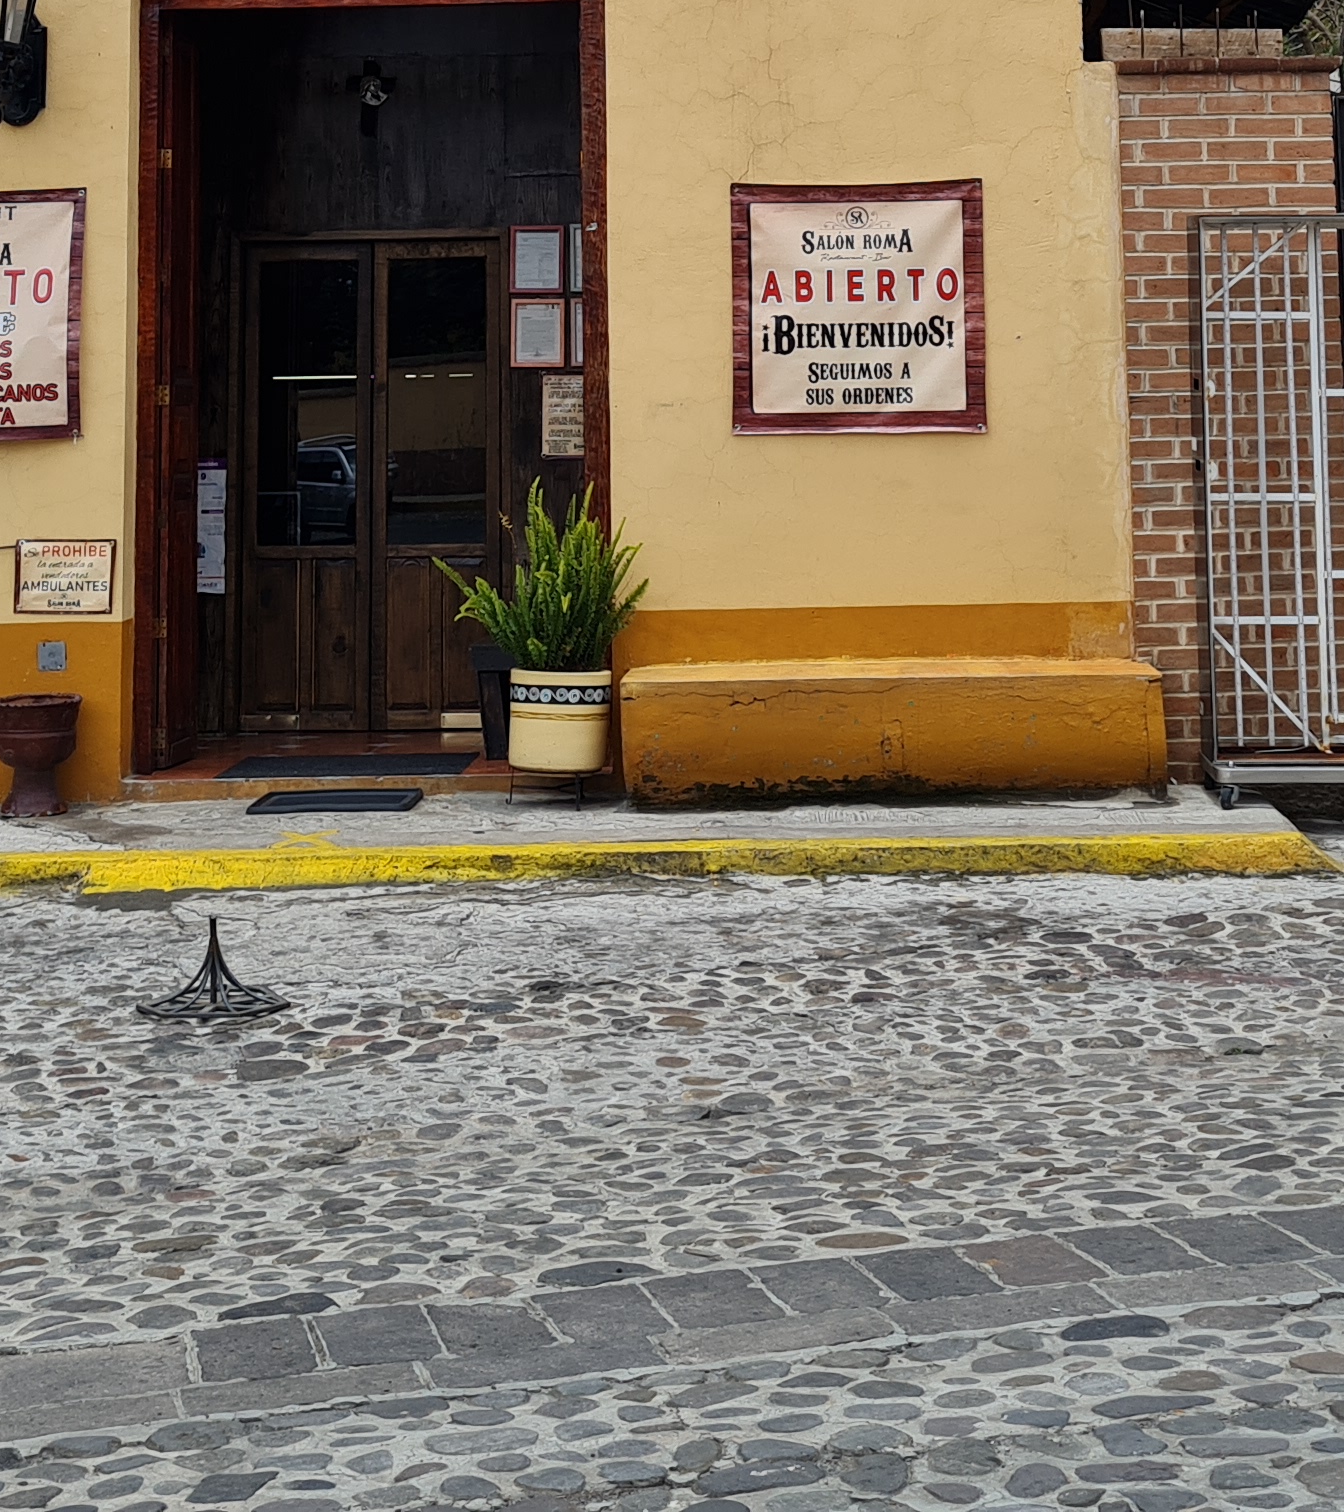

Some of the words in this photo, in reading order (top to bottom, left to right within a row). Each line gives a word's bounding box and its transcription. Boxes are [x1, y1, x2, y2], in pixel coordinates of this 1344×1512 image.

[863, 228, 913, 254] ROMA
[761, 268, 959, 303] ABIERTO
[762, 315, 955, 355] ¡BIENVENIDOS!
[808, 361, 893, 384] SEGUIMOS
[900, 362, 911, 380] A
[806, 388, 834, 405] SUS
[842, 387, 913, 405] ORDENES
[42, 542, 107, 557] PROHÍBE
[48, 560, 85, 568] entrada
[21, 580, 108, 592] AMBULANTES
